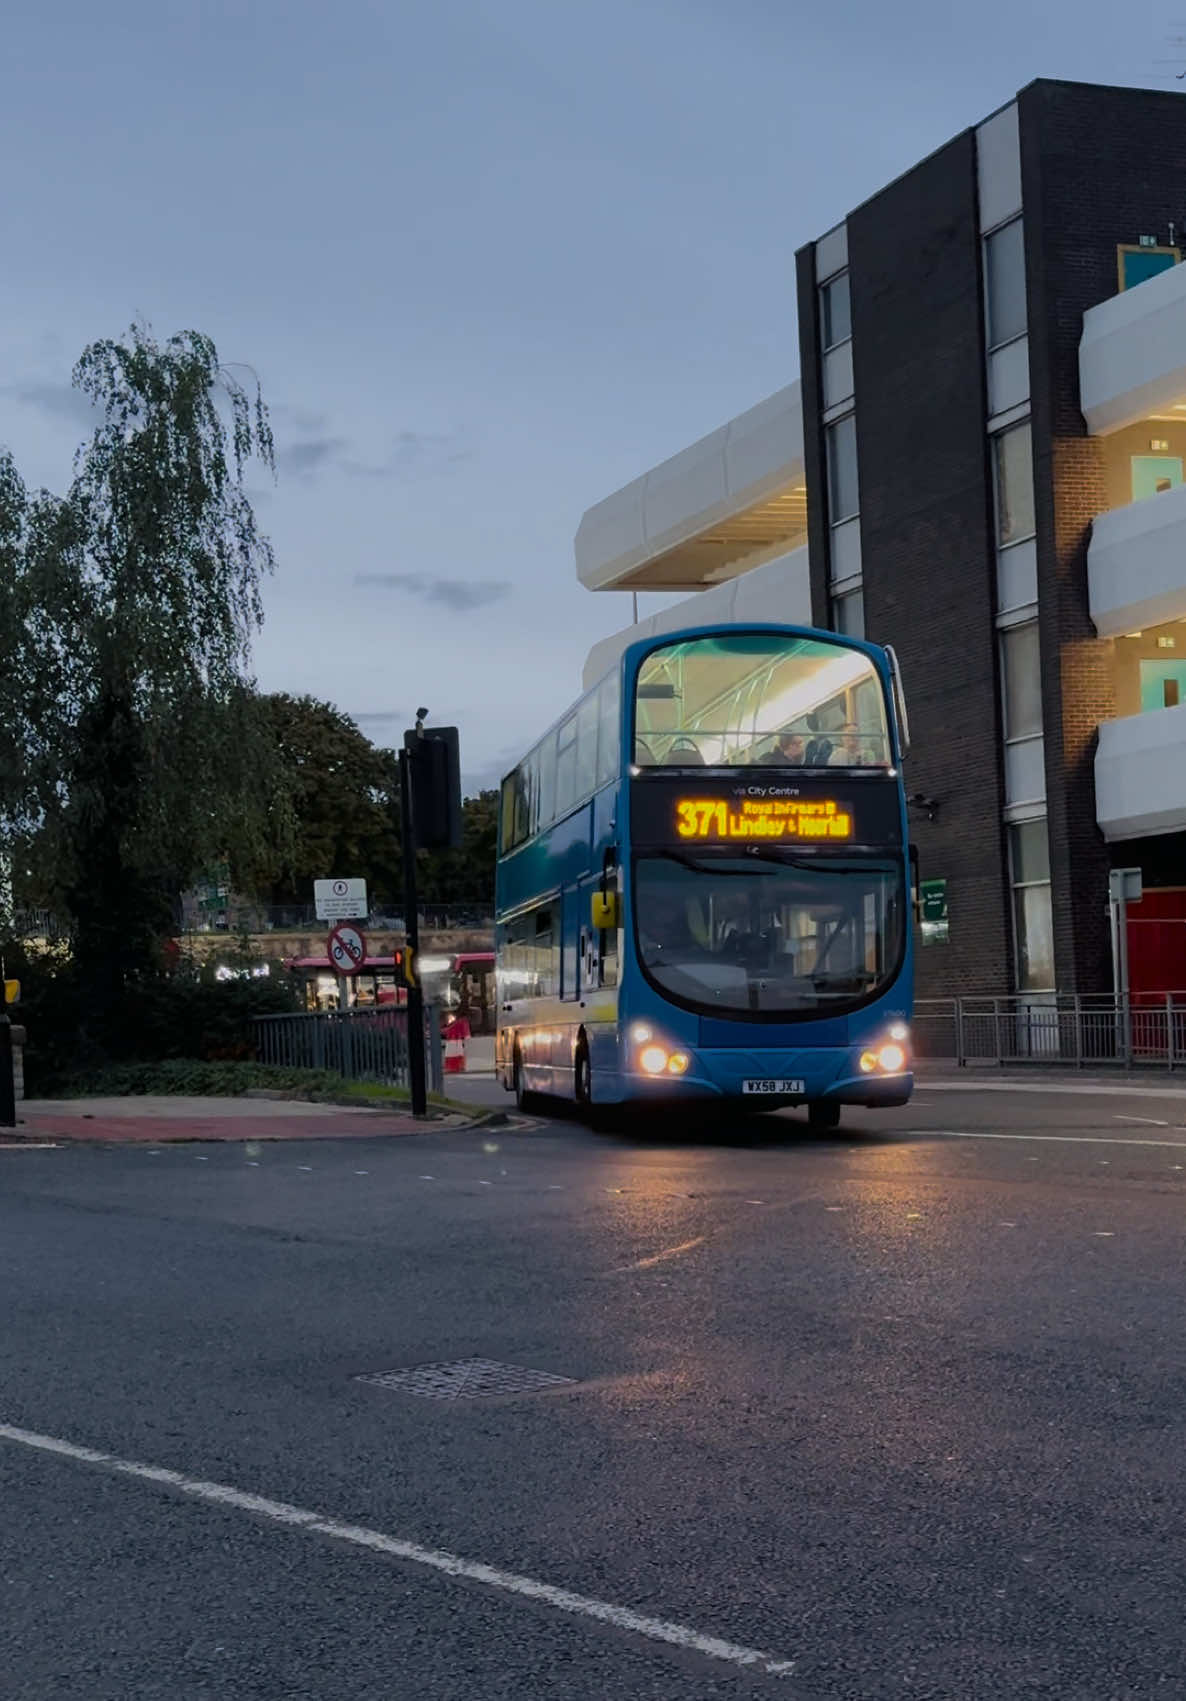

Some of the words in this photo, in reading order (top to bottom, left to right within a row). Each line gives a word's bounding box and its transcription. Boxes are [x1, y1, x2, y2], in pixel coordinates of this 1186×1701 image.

[747, 786, 767, 797] City
[768, 786, 800, 796] Centre
[743, 802, 773, 814] Royal
[678, 802, 727, 836] 371
[730, 815, 786, 836] Lindley
[748, 1080, 777, 1092] WX58
[779, 1080, 800, 1092] JXJ
